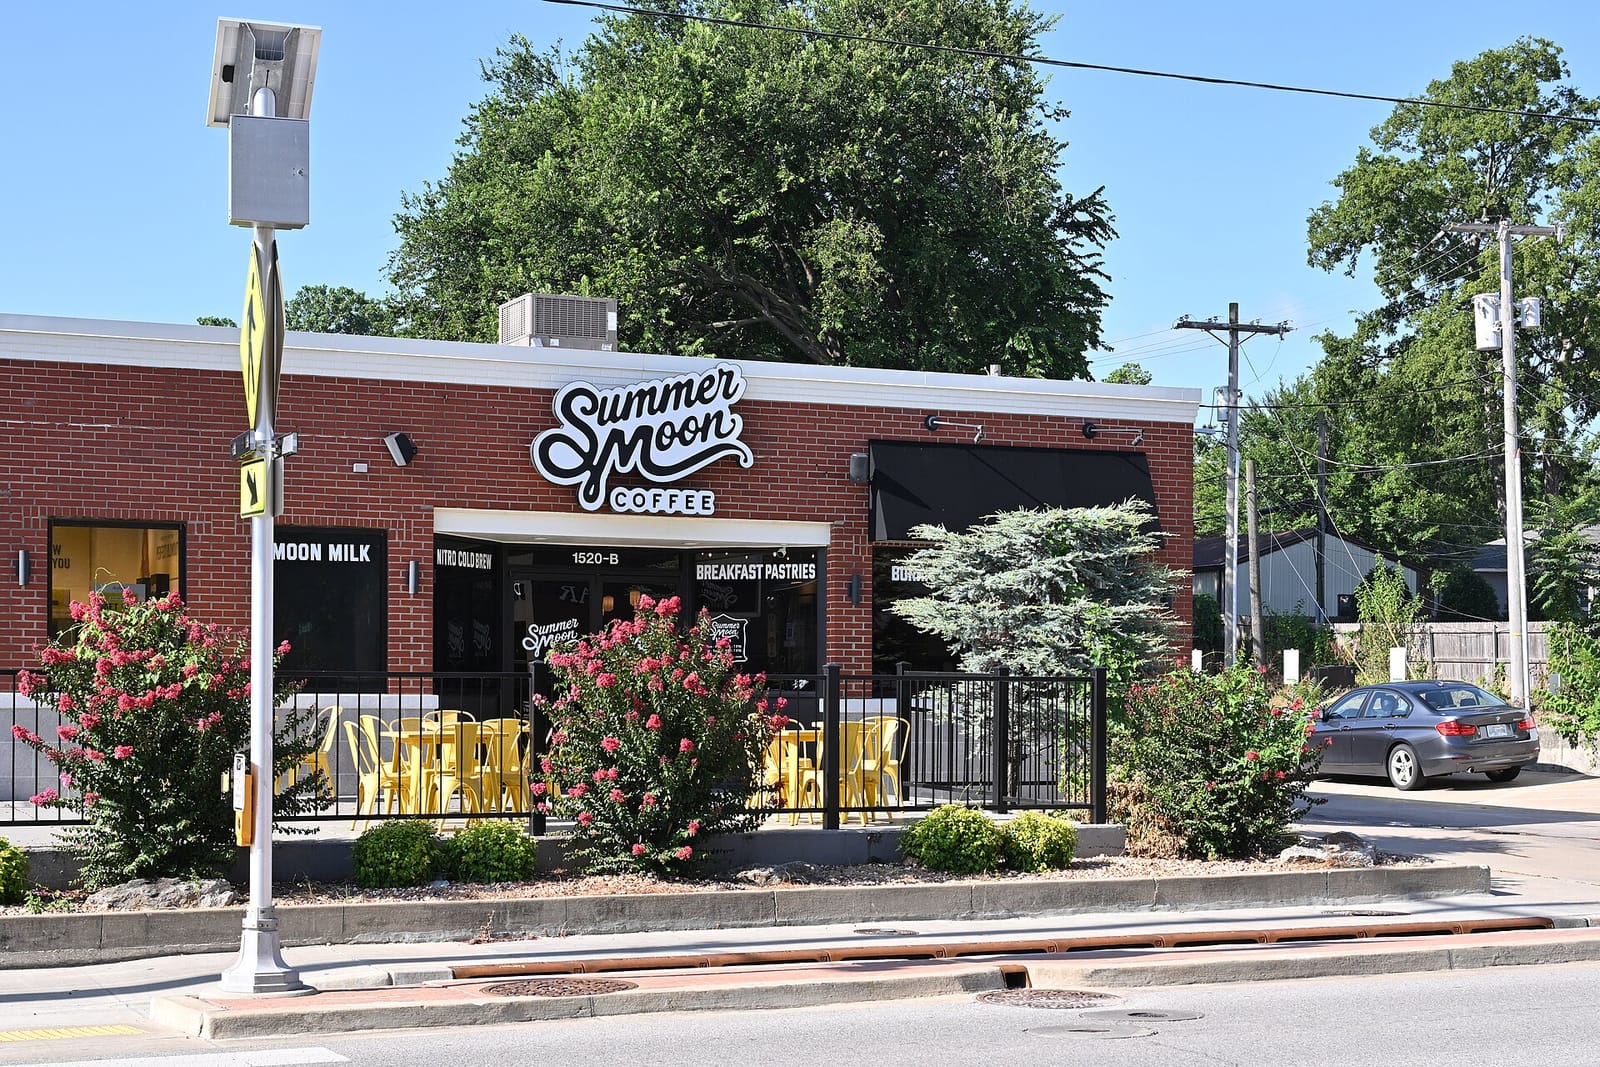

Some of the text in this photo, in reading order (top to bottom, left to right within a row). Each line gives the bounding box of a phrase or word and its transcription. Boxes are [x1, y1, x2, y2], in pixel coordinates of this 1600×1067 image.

[539, 368, 739, 477] Summer
[583, 410, 750, 502] Moon
[614, 492, 714, 510] COFFEE
[273, 542, 371, 562] MOON MILK
[436, 548, 493, 570] NITRO COLD BREW
[572, 552, 619, 565] 1520-B
[696, 563, 816, 580] BREAKFAST PASTRIES
[522, 618, 579, 651] Summer
[534, 630, 579, 658] Moon
